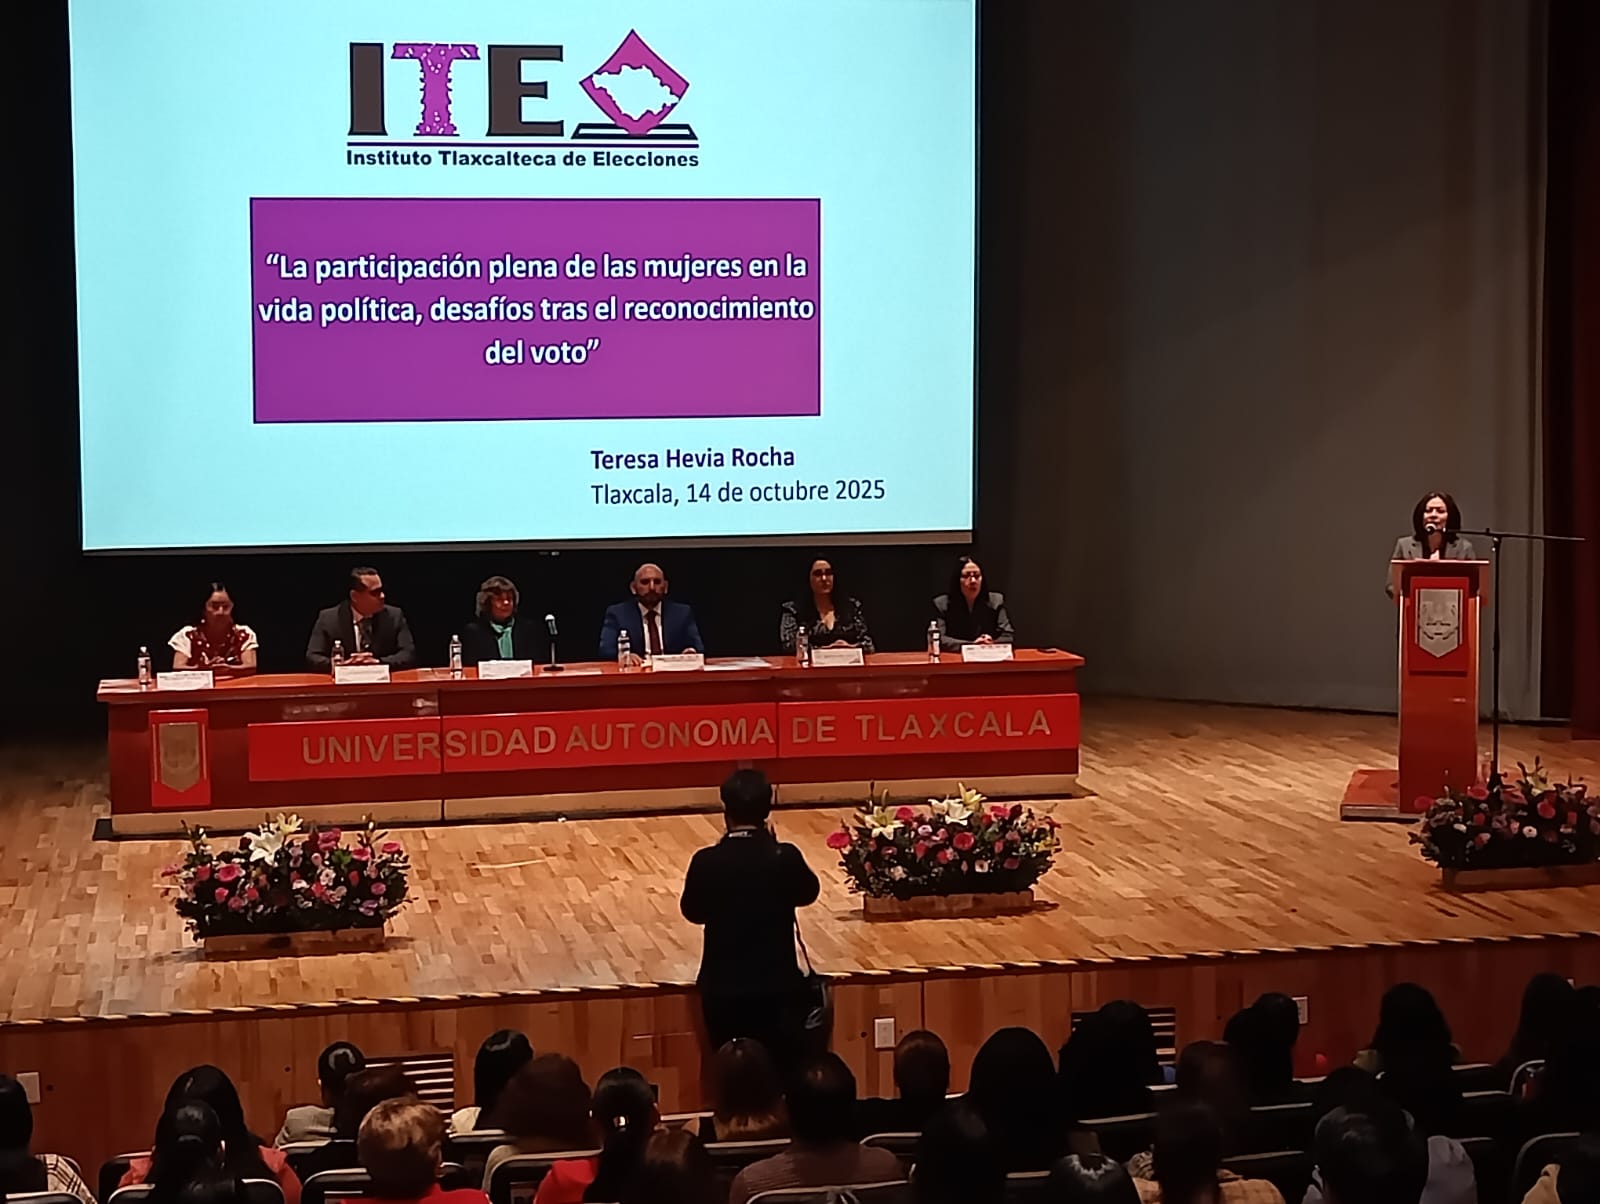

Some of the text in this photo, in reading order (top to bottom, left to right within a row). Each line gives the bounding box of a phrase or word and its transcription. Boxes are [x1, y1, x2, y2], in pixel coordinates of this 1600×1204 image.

[348, 42, 564, 137] ITE
[347, 150, 699, 167] Instituto Tlaxcalteca de Elecciones
[265, 253, 807, 284] “La participación plena de las mujeres en la
[258, 295, 814, 328] vida política, desafíos tras el reconocimiento
[485, 338, 600, 364] del voto”
[591, 446, 795, 469] Teresa Hevia Rocha
[591, 479, 885, 507] Tlaxcala, 14 de octubre 2025
[303, 709, 1051, 765] UNIVERSIDAD AUTONOMA DE TLAXCALA
